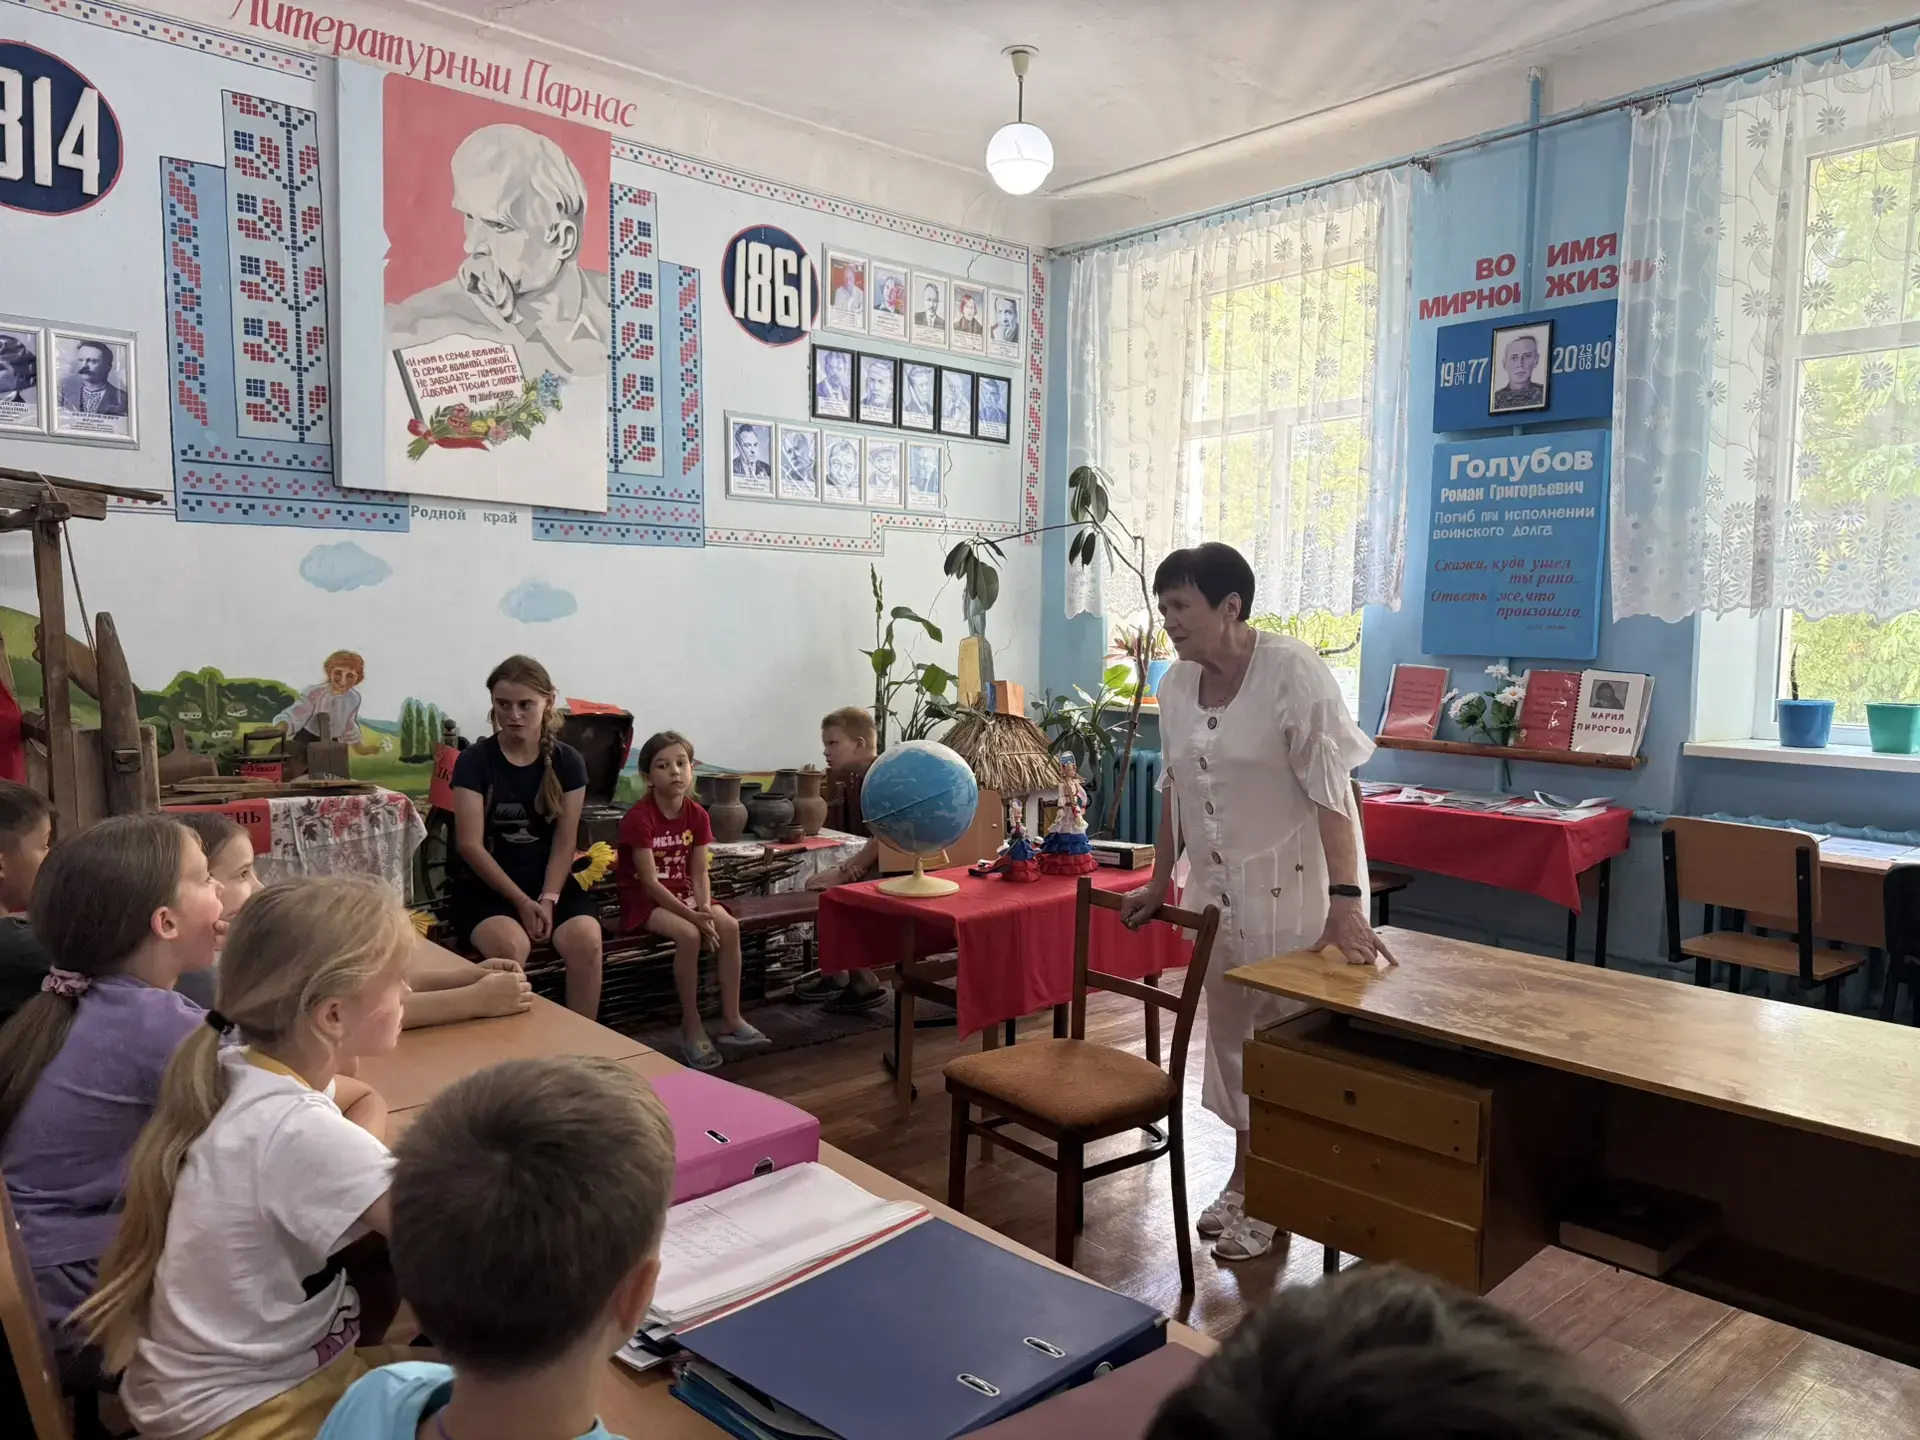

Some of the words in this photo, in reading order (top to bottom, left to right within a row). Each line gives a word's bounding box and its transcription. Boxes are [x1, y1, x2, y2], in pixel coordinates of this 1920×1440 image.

[520, 58, 638, 127] Парнас
[1475, 253, 1517, 281] ВО
[1546, 232, 1618, 268] ИМЯ
[733, 239, 812, 332] 1861
[1449, 446, 1594, 482] Голубов
[1440, 486, 1484, 503] Роман
[1489, 480, 1584, 501] Григорьевич
[410, 504, 467, 521] Родной
[483, 511, 518, 525] край
[1434, 509, 1476, 524] Погиб
[1504, 506, 1596, 521] исполнении
[1432, 525, 1505, 540] воинского
[1511, 524, 1553, 538] долга
[1508, 573, 1534, 584] ты
[1590, 711, 1625, 721] МАРИЯ
[1576, 722, 1632, 735] ПИРОГОВА
